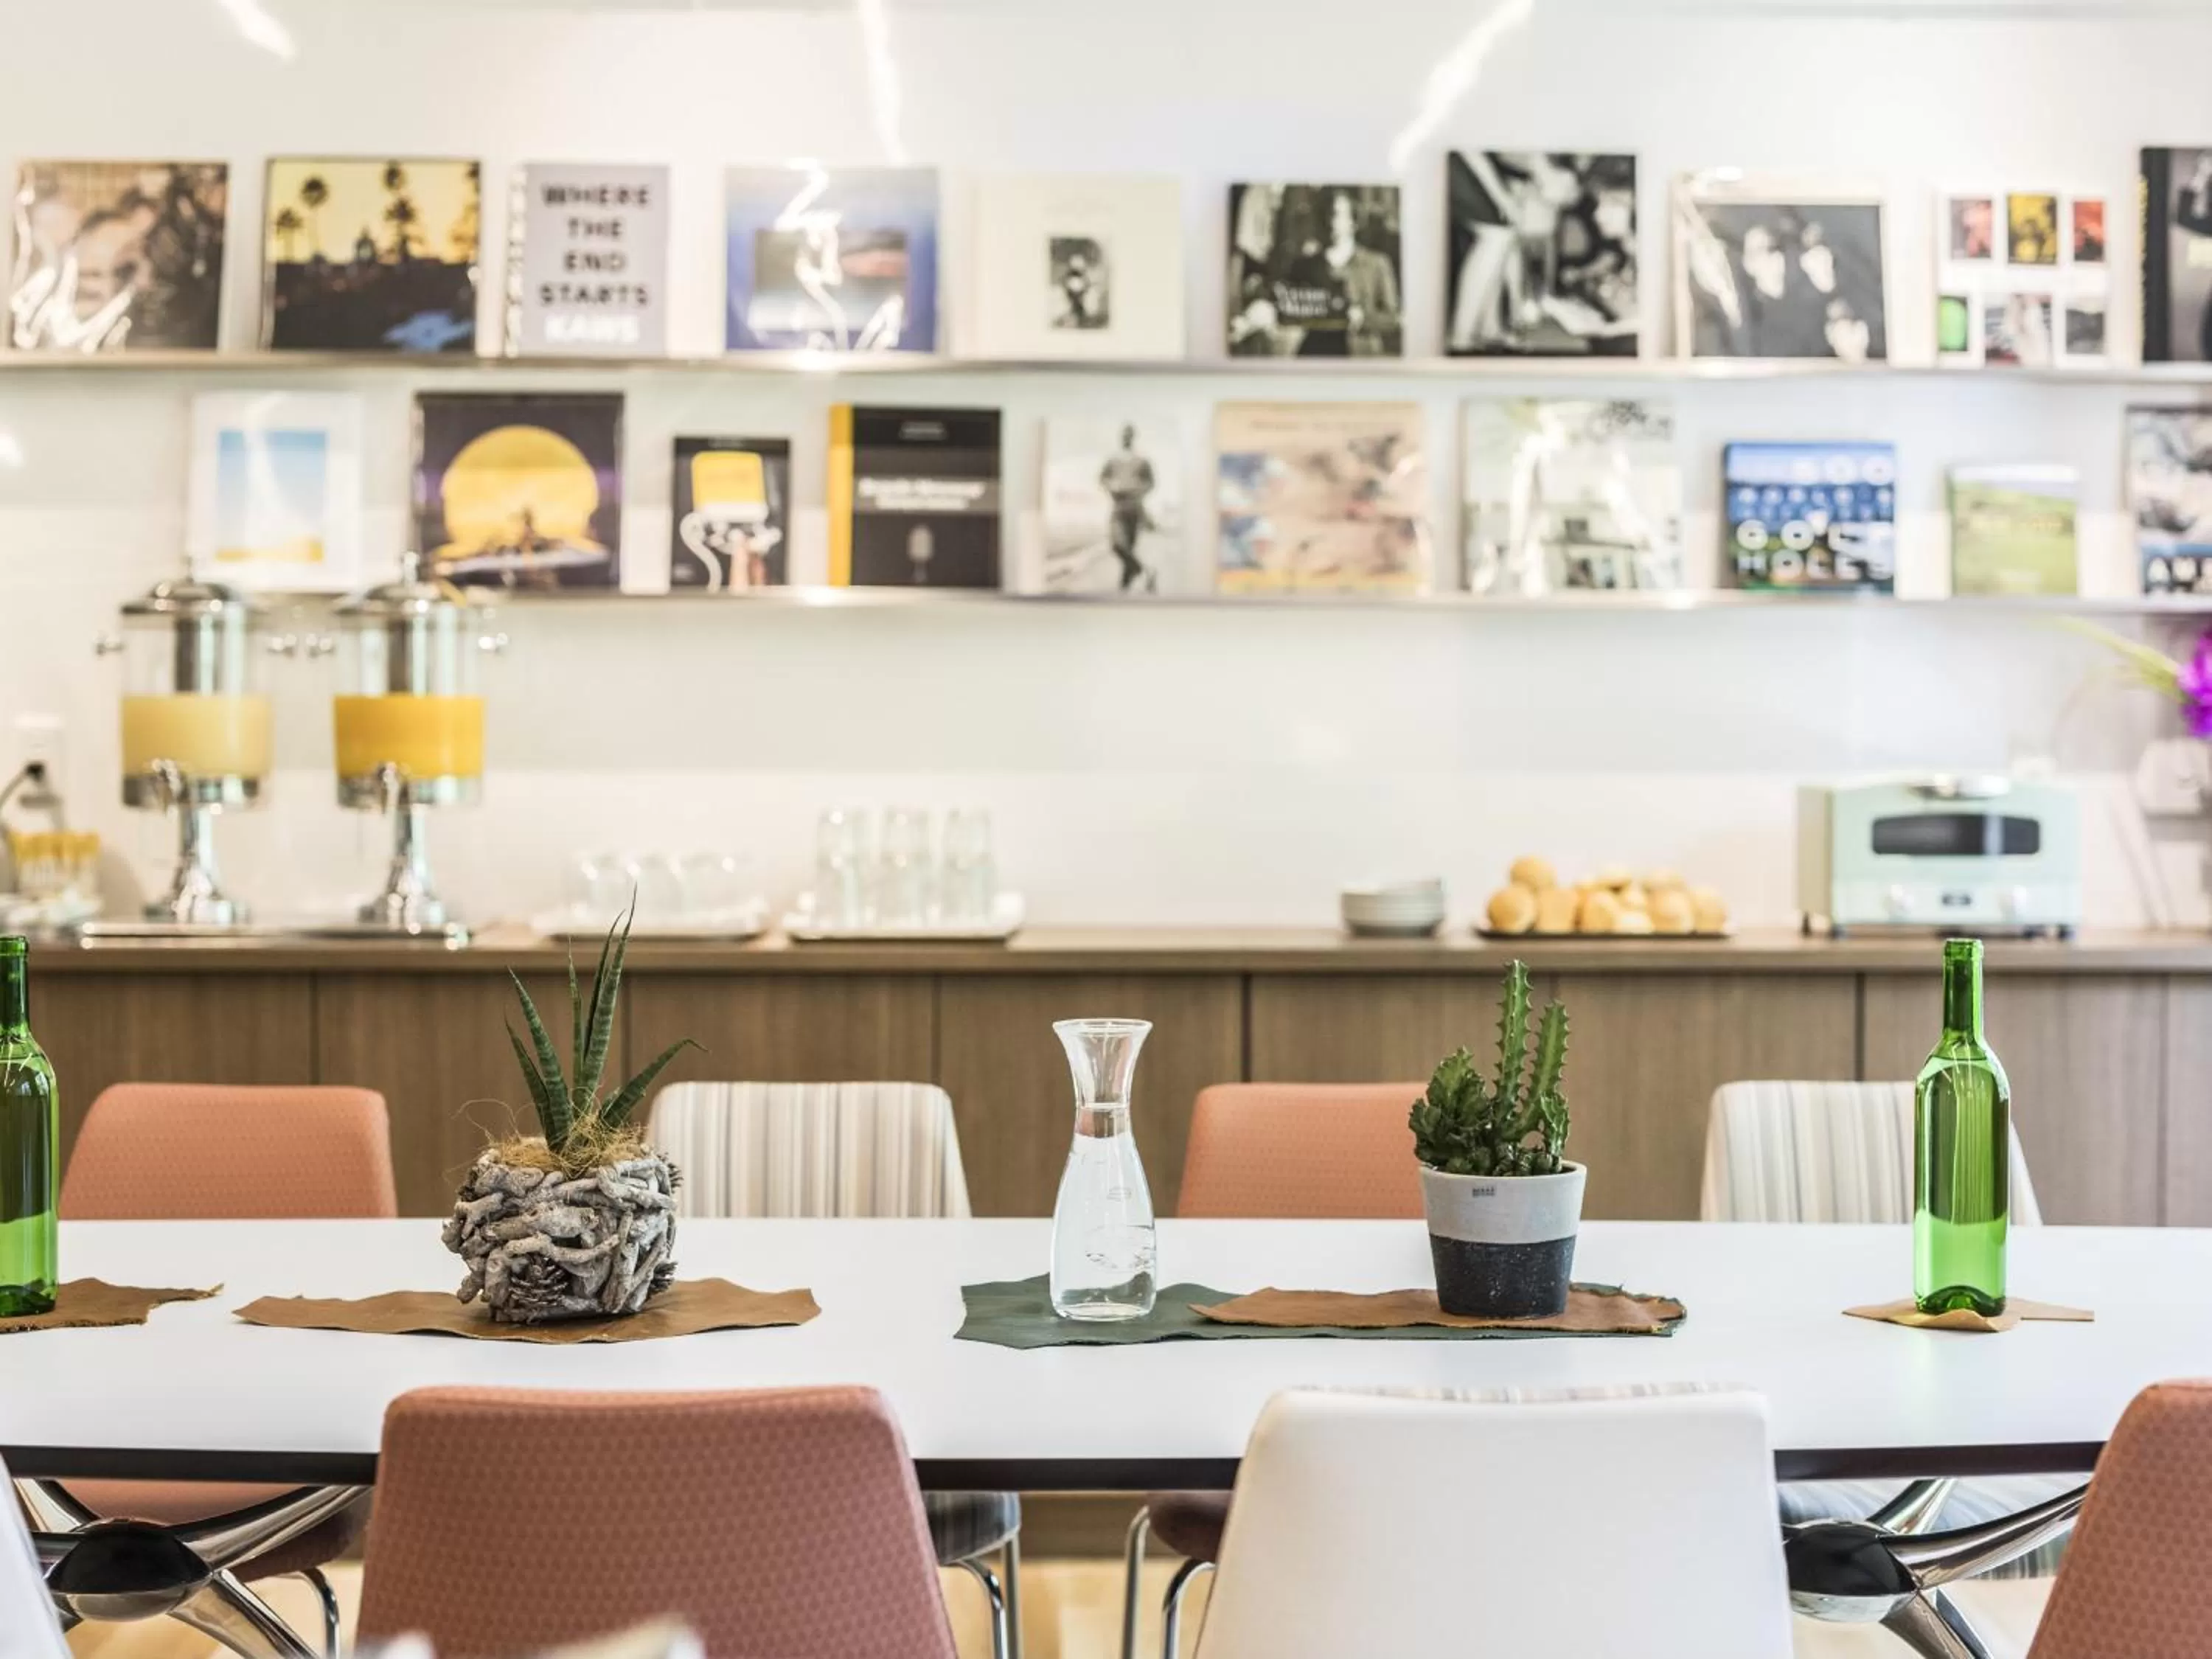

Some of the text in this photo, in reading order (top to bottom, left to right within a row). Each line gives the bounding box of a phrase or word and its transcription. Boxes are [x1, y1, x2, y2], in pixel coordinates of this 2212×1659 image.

[542, 187, 649, 206] WHERE
[568, 218, 621, 238] THE
[564, 251, 627, 272] END
[540, 283, 649, 305] STARTS
[1736, 519, 1893, 552] GOL
